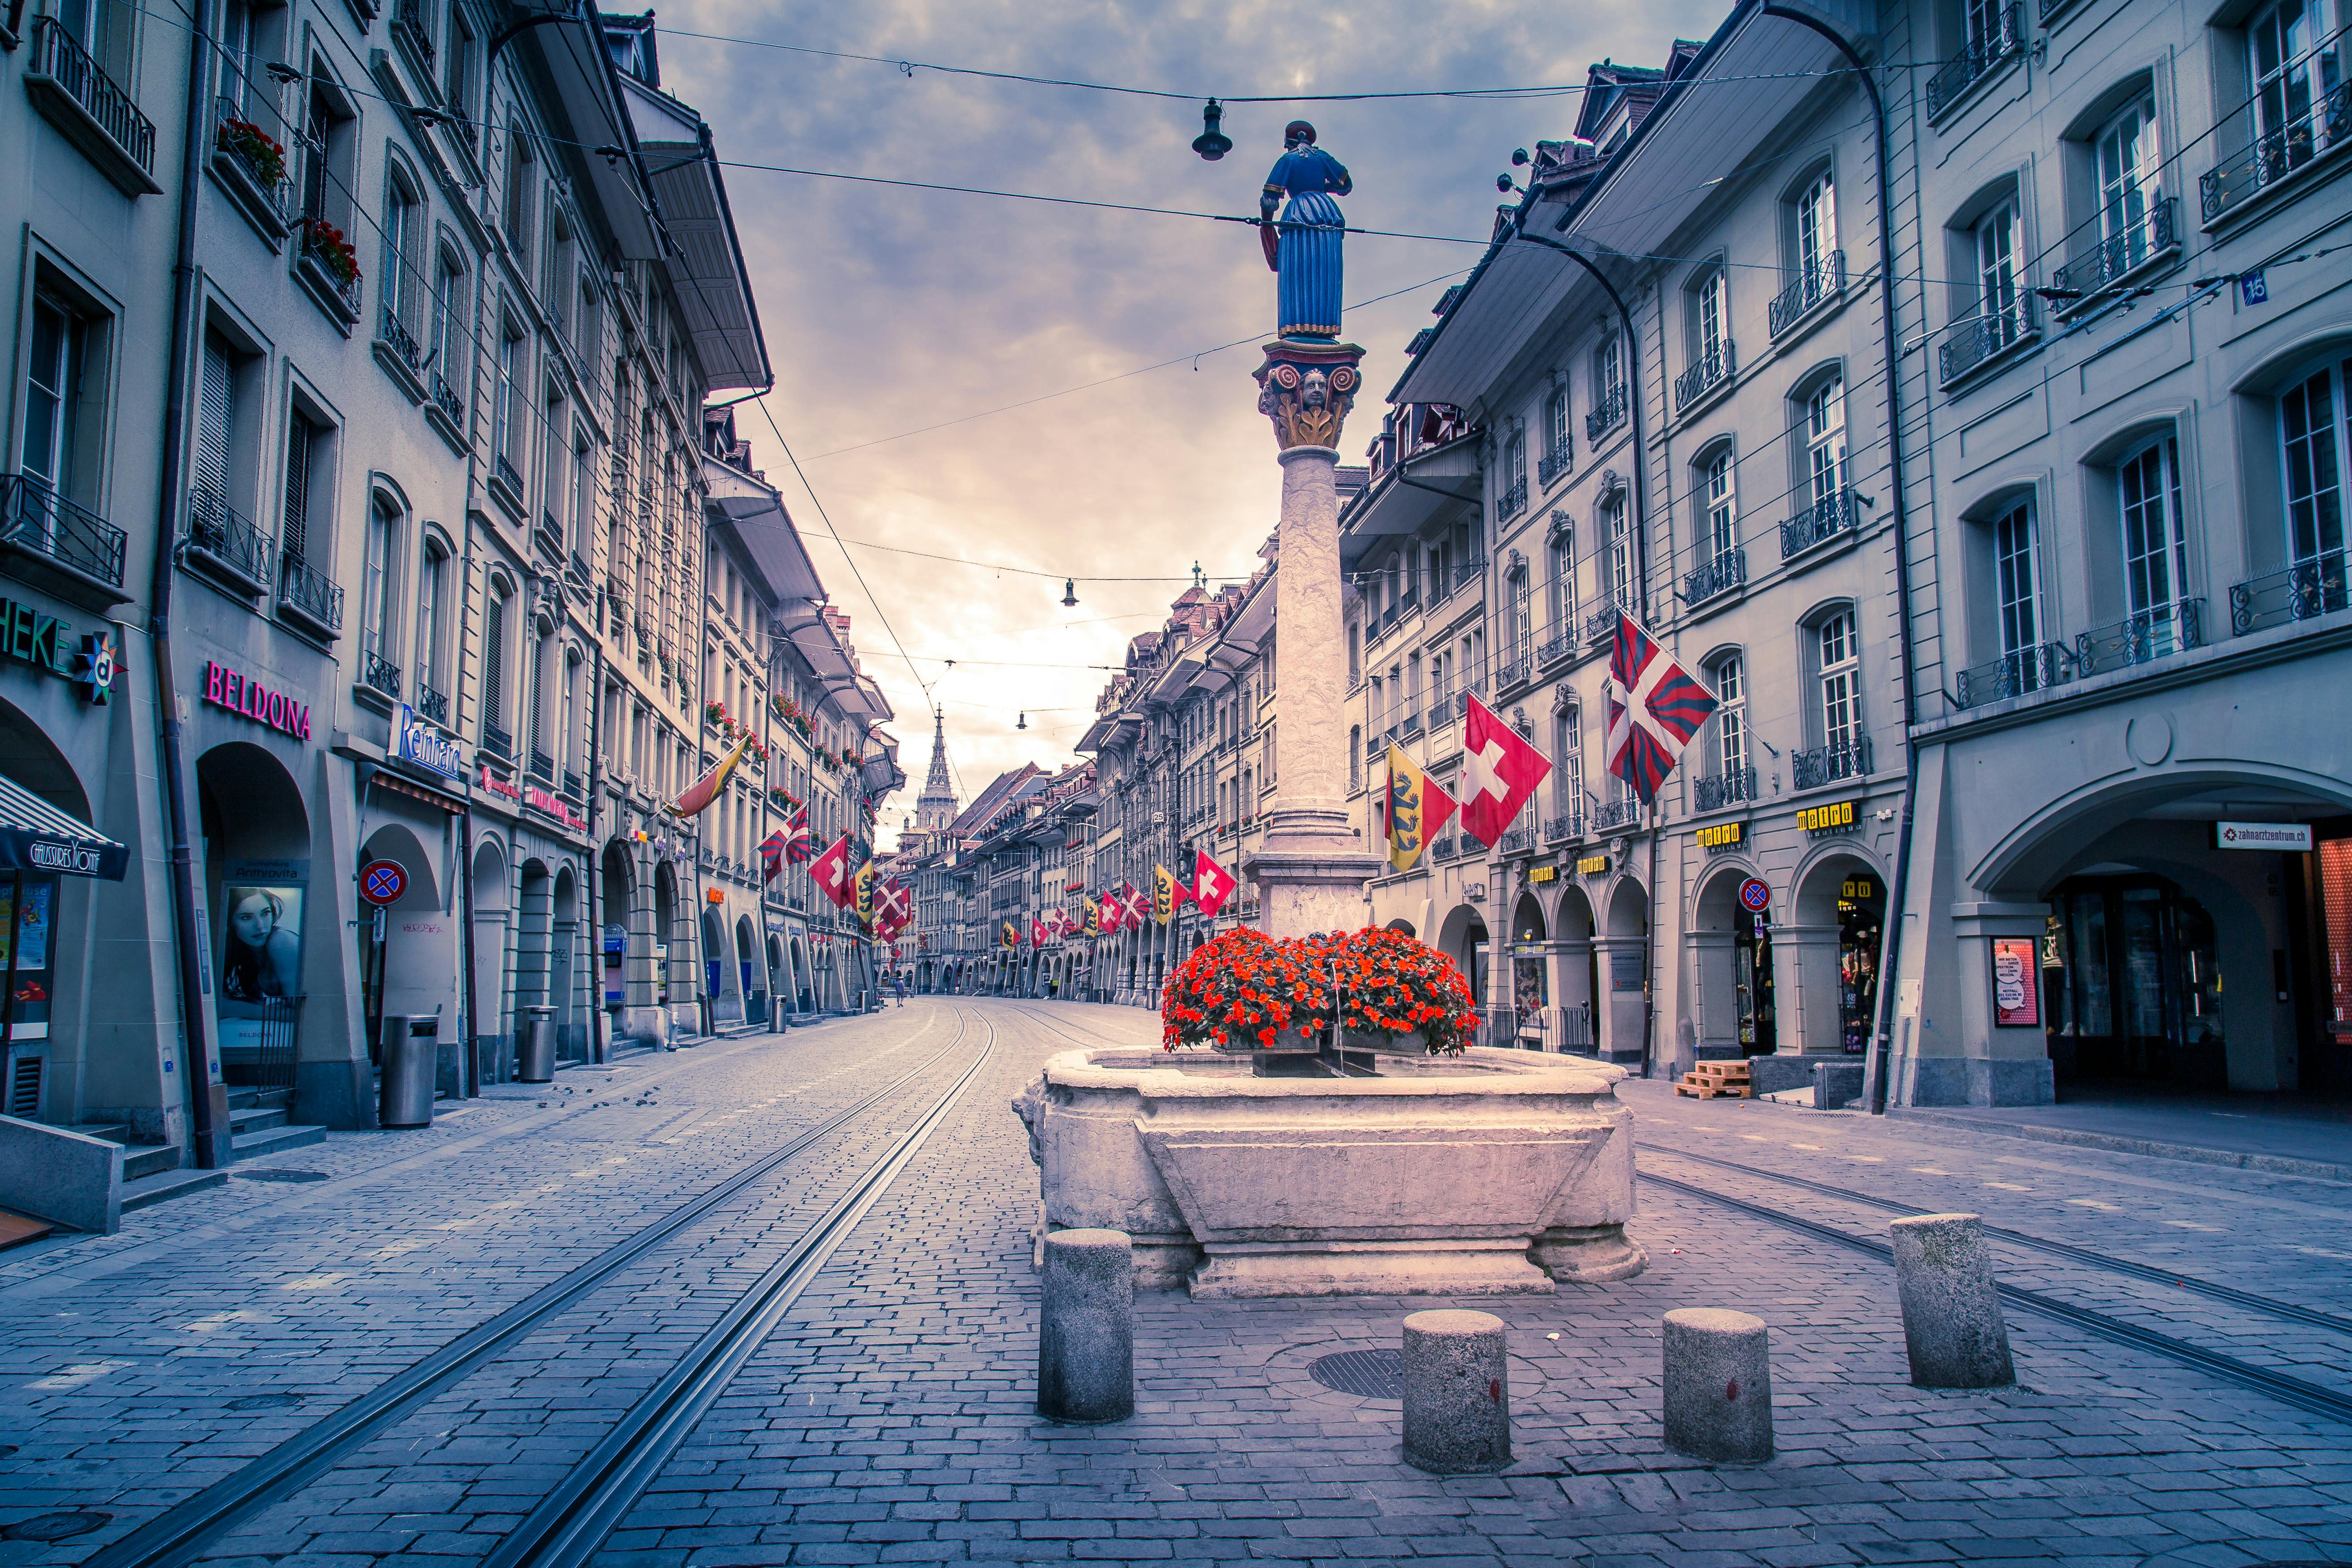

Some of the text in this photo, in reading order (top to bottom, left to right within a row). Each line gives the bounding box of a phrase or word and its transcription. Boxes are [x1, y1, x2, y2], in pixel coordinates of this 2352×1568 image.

[2246, 277, 2265, 299] 15
[207, 661, 312, 741] BELDONA
[394, 702, 461, 776] Reinhard
[1798, 807, 1850, 829] metro
[1697, 827, 1738, 845] metro
[2238, 829, 2305, 842] zahnarztzentrum.ch
[30, 844, 72, 867] CHAUSSURES
[1577, 858, 1604, 873] metro
[236, 868, 298, 879] Anthrovita
[1530, 869, 1553, 882] metro
